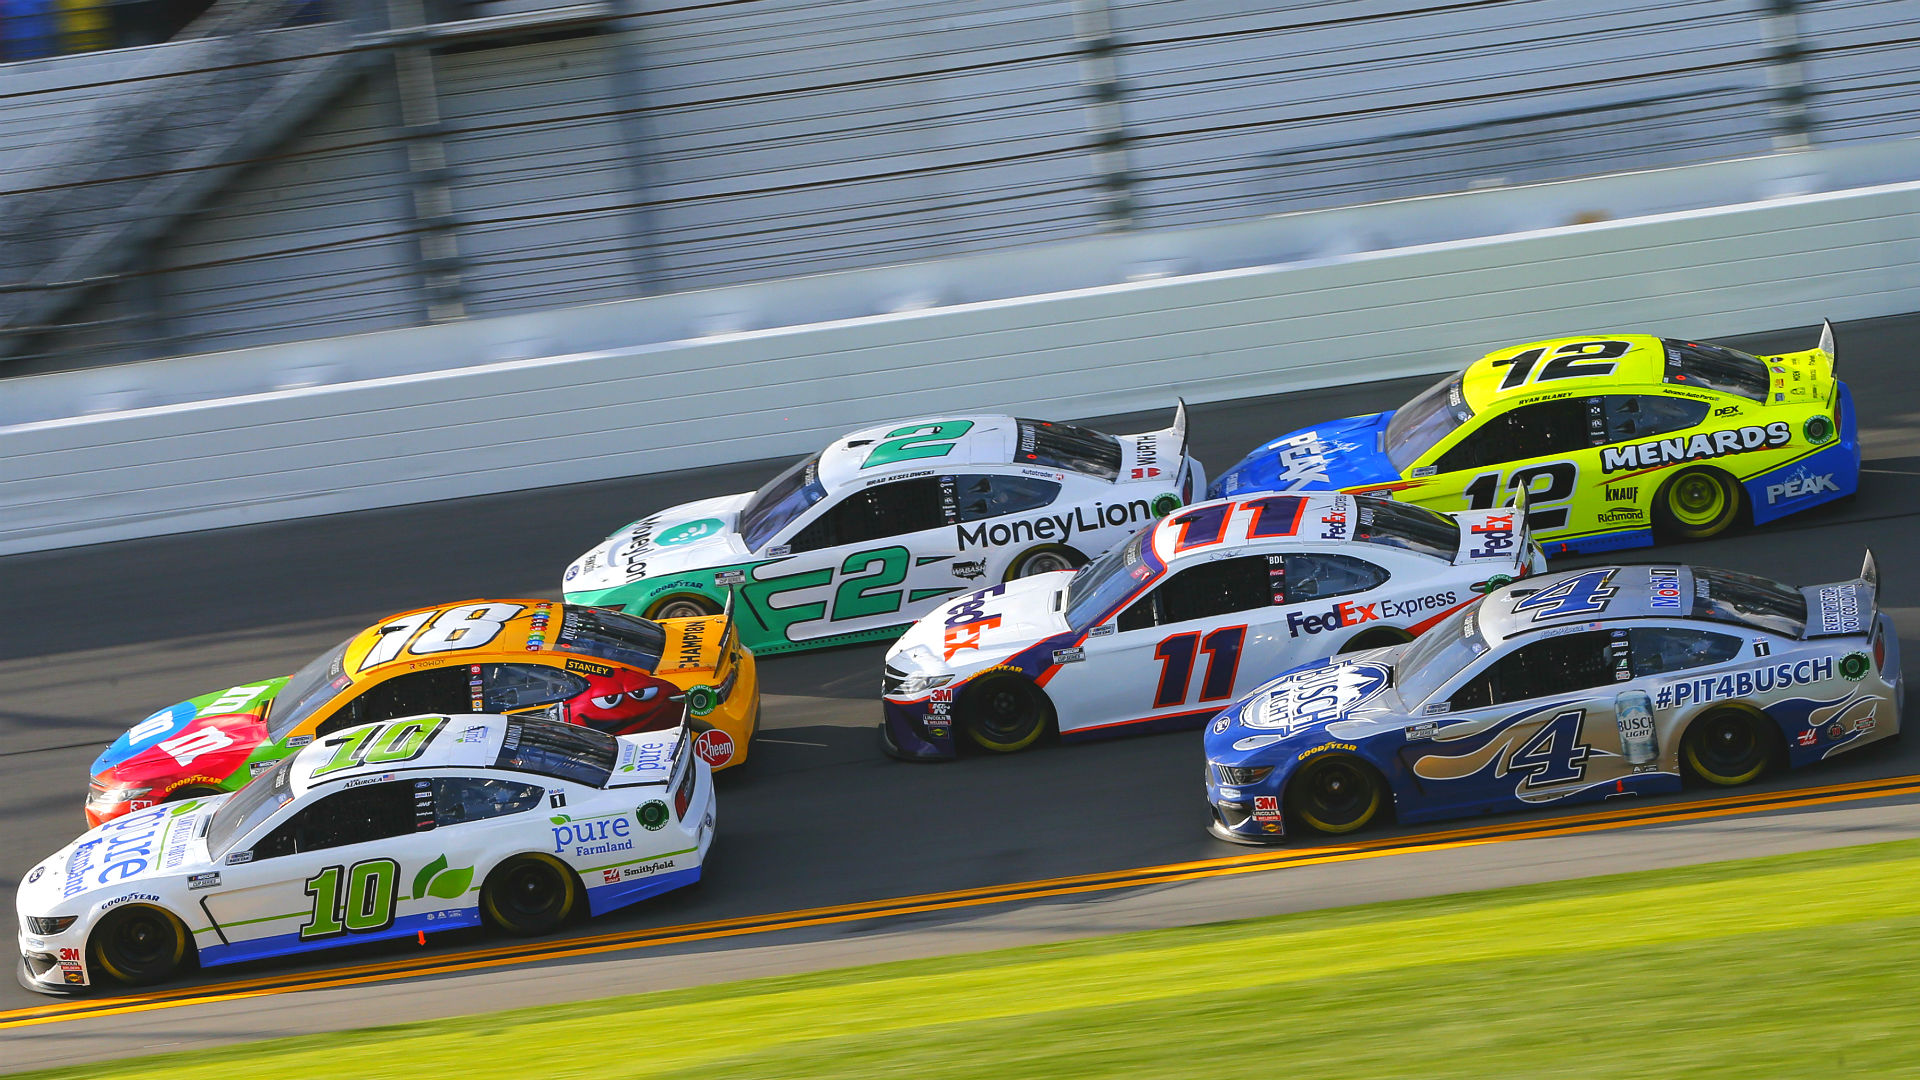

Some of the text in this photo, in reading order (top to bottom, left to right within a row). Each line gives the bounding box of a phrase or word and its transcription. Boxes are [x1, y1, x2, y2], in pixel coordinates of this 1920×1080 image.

[1497, 341, 1634, 393] 12
[1519, 392, 1573, 406] RYAN BLANEY
[1714, 405, 1740, 417] DEX
[860, 420, 976, 470] 2
[1602, 421, 1792, 471] MENARDS
[1022, 468, 1054, 480] Autotrader
[1268, 431, 1330, 491] PEAK
[866, 470, 935, 487] BRAD KESELOWSKI
[1766, 472, 1841, 505] PEAK
[1462, 460, 1580, 535] 12
[956, 499, 1151, 552] MoneyLion
[1168, 496, 1311, 554] 11
[1321, 512, 1346, 540] FedEx
[1597, 509, 1644, 524] Richmond
[1470, 514, 1514, 559] FedEx
[952, 564, 985, 576] WABASH
[1269, 555, 1285, 565] BDL
[650, 580, 704, 597] GOODYEAR
[831, 545, 911, 622] 2
[1511, 568, 1620, 622] 4
[944, 583, 1007, 662] FedEx
[1286, 590, 1457, 639] FedEx Express
[1823, 612, 1840, 632] EVERY
[1841, 617, 1859, 633] YOU
[357, 603, 527, 673] 18
[567, 661, 609, 675] STANLEY
[966, 663, 1023, 682] GOODYEAR
[1152, 624, 1249, 710] 11
[931, 689, 951, 701] 3M
[1655, 656, 1835, 710] #PIT4BUSCH
[1618, 715, 1655, 732] BUSCH
[1625, 728, 1649, 738] LIGHT
[310, 714, 450, 779] 10
[637, 743, 666, 771] pure
[697, 735, 734, 760] Rheem
[1298, 741, 1358, 761] GOODYEAR
[1507, 708, 1591, 789] 4
[165, 775, 222, 793] GOODYEAR
[1255, 797, 1277, 810] 3M
[98, 807, 168, 884] pure
[551, 817, 631, 853] pure
[576, 840, 633, 857] Farmland
[63, 837, 103, 898] Farmland
[624, 860, 676, 877] Smithfield
[102, 892, 160, 910] GOODYEAR
[299, 857, 401, 942] 10
[59, 947, 80, 961] 3M
